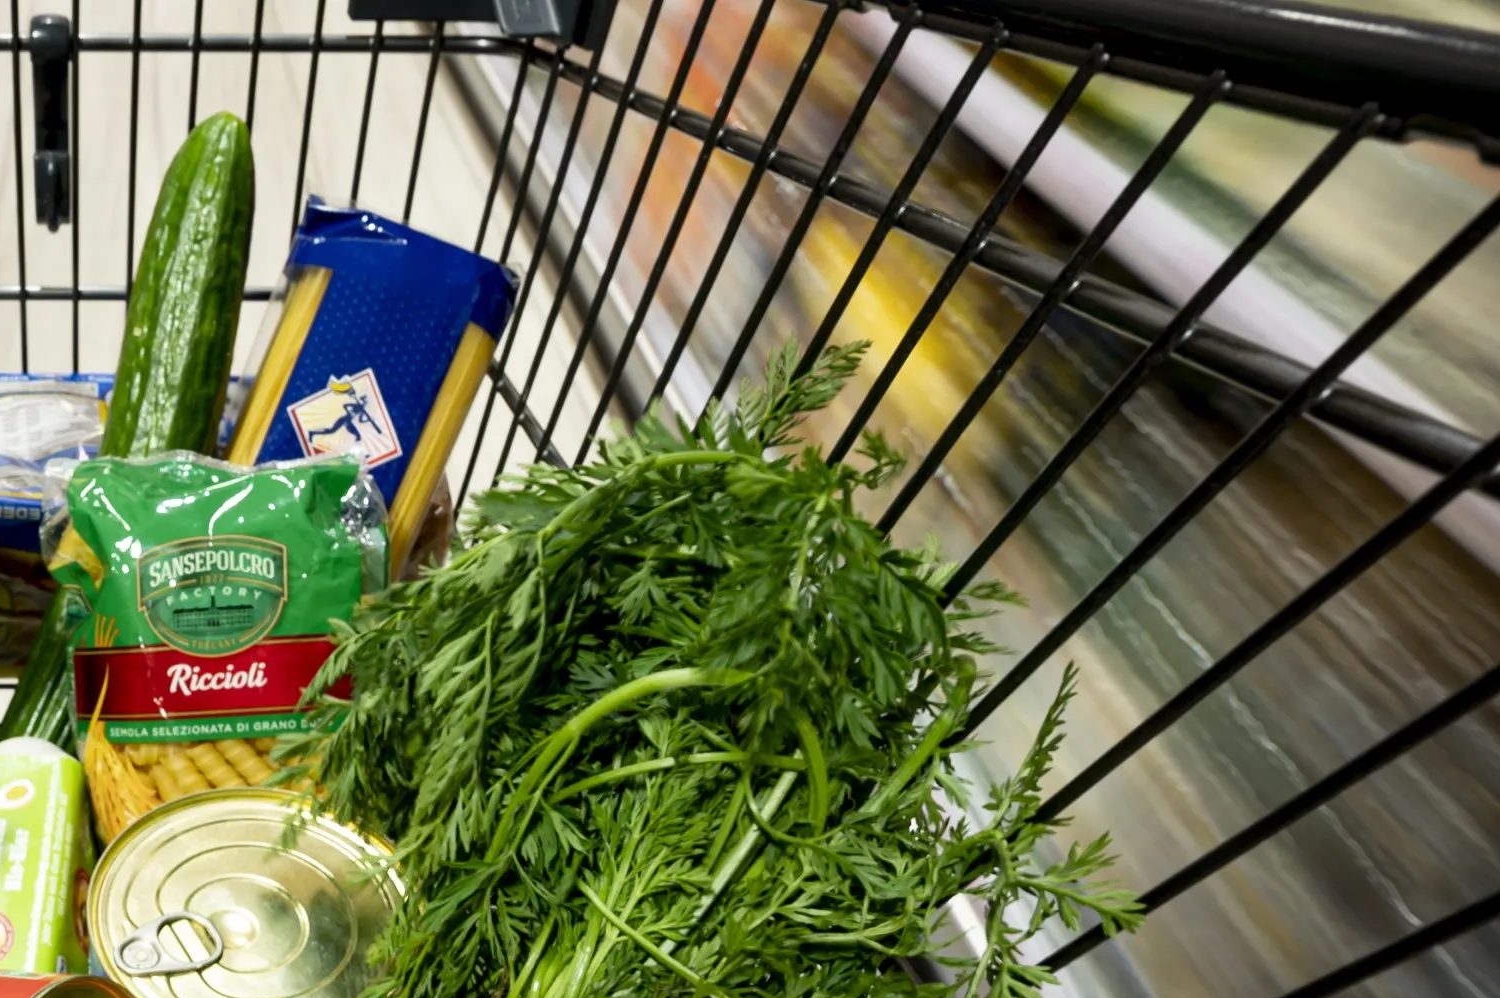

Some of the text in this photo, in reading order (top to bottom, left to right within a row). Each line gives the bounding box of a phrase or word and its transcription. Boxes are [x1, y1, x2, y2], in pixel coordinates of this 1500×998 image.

[149, 549, 276, 588] SANSEPOLCRO
[166, 585, 263, 607] FACTORY
[166, 661, 268, 696] Riccioli
[109, 726, 149, 738] SEMOLA
[152, 723, 233, 737] SELEZIONATA
[236, 722, 250, 733] DI
[253, 719, 297, 732] GRANO
